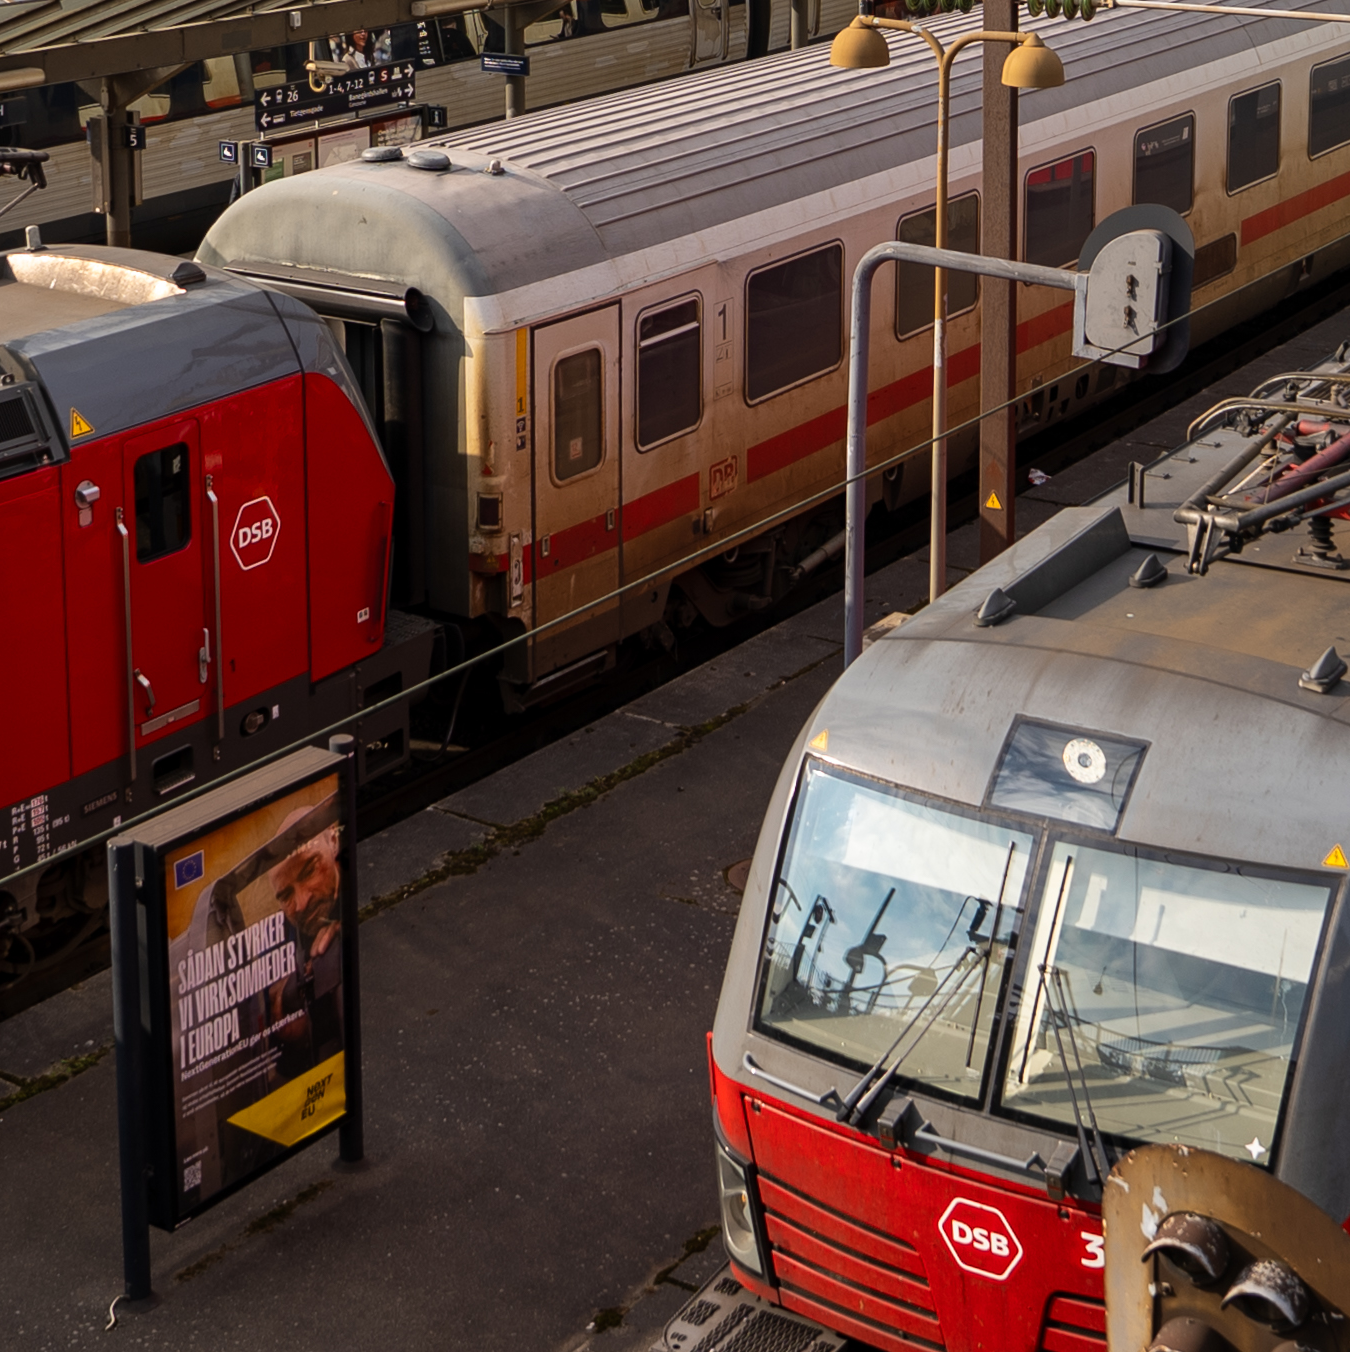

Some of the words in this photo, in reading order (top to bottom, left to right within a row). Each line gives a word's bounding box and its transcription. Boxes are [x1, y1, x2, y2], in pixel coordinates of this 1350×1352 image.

[287, 91, 299, 103] 26
[329, 83, 345, 95] 1-4,
[346, 79, 364, 91] 7-12
[380, 69, 388, 81] S
[130, 134, 138, 147] 5
[717, 303, 727, 340] 1
[517, 396, 524, 413] 1
[238, 517, 274, 549] DSB
[84, 791, 118, 814] SIEMENS
[13, 854, 20, 864] G
[178, 940, 225, 994] SÅDAN
[227, 910, 285, 969] STYRKER
[178, 990, 194, 1032] VI
[195, 941, 296, 1025] VIRKSOMHEDER
[180, 1035, 186, 1069] I
[188, 1008, 241, 1067] EUROPA
[181, 1036, 249, 1082] NextGenerationEU
[301, 1103, 315, 1120] EU
[951, 1219, 1010, 1257] DSB
[1080, 1231, 1105, 1268] 3
